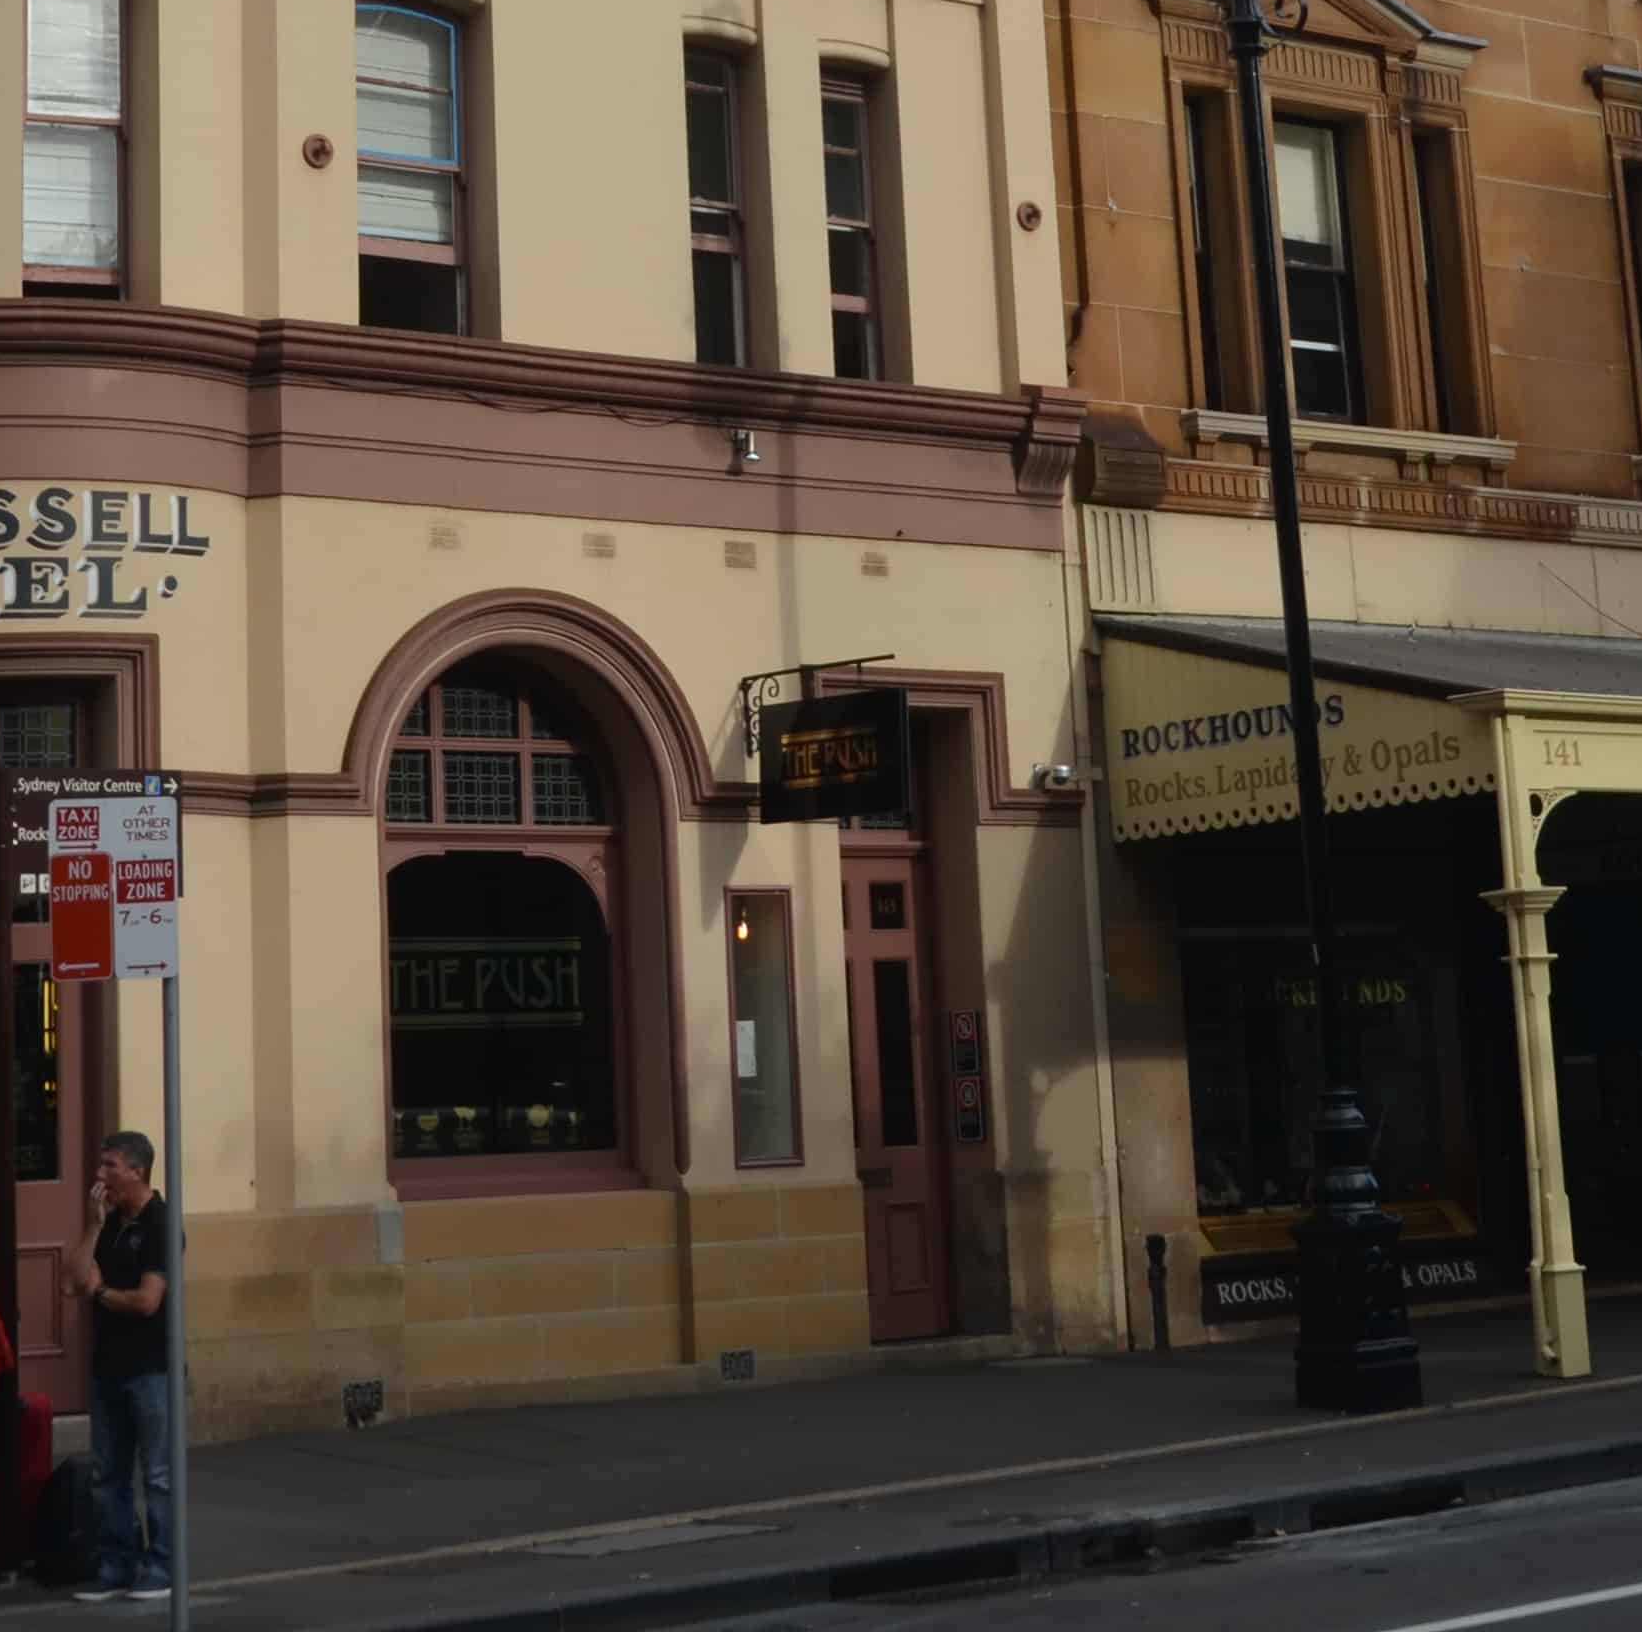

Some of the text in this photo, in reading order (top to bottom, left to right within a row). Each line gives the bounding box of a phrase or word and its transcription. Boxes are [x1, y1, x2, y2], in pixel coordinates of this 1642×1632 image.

[1121, 694, 1345, 759] ROCKHOUNS
[782, 741, 822, 779] THE
[1542, 738, 1582, 767] 141
[1216, 752, 1336, 802] Lapiday
[1342, 742, 1363, 777] &
[1370, 730, 1461, 784] Opals
[18, 777, 142, 794] Sydney Visitor Centre
[58, 808, 98, 823] TAXI
[136, 804, 156, 816] AT
[58, 824, 98, 841] ZONE
[122, 817, 171, 830] OTHER
[127, 830, 168, 842] TIMES
[68, 861, 93, 880] NO
[118, 862, 173, 881] LOADING
[52, 883, 110, 903] STOPPING
[126, 882, 166, 900] ZONE
[393, 957, 582, 1009] THE PUSH
[1417, 1260, 1478, 1286] OPALS
